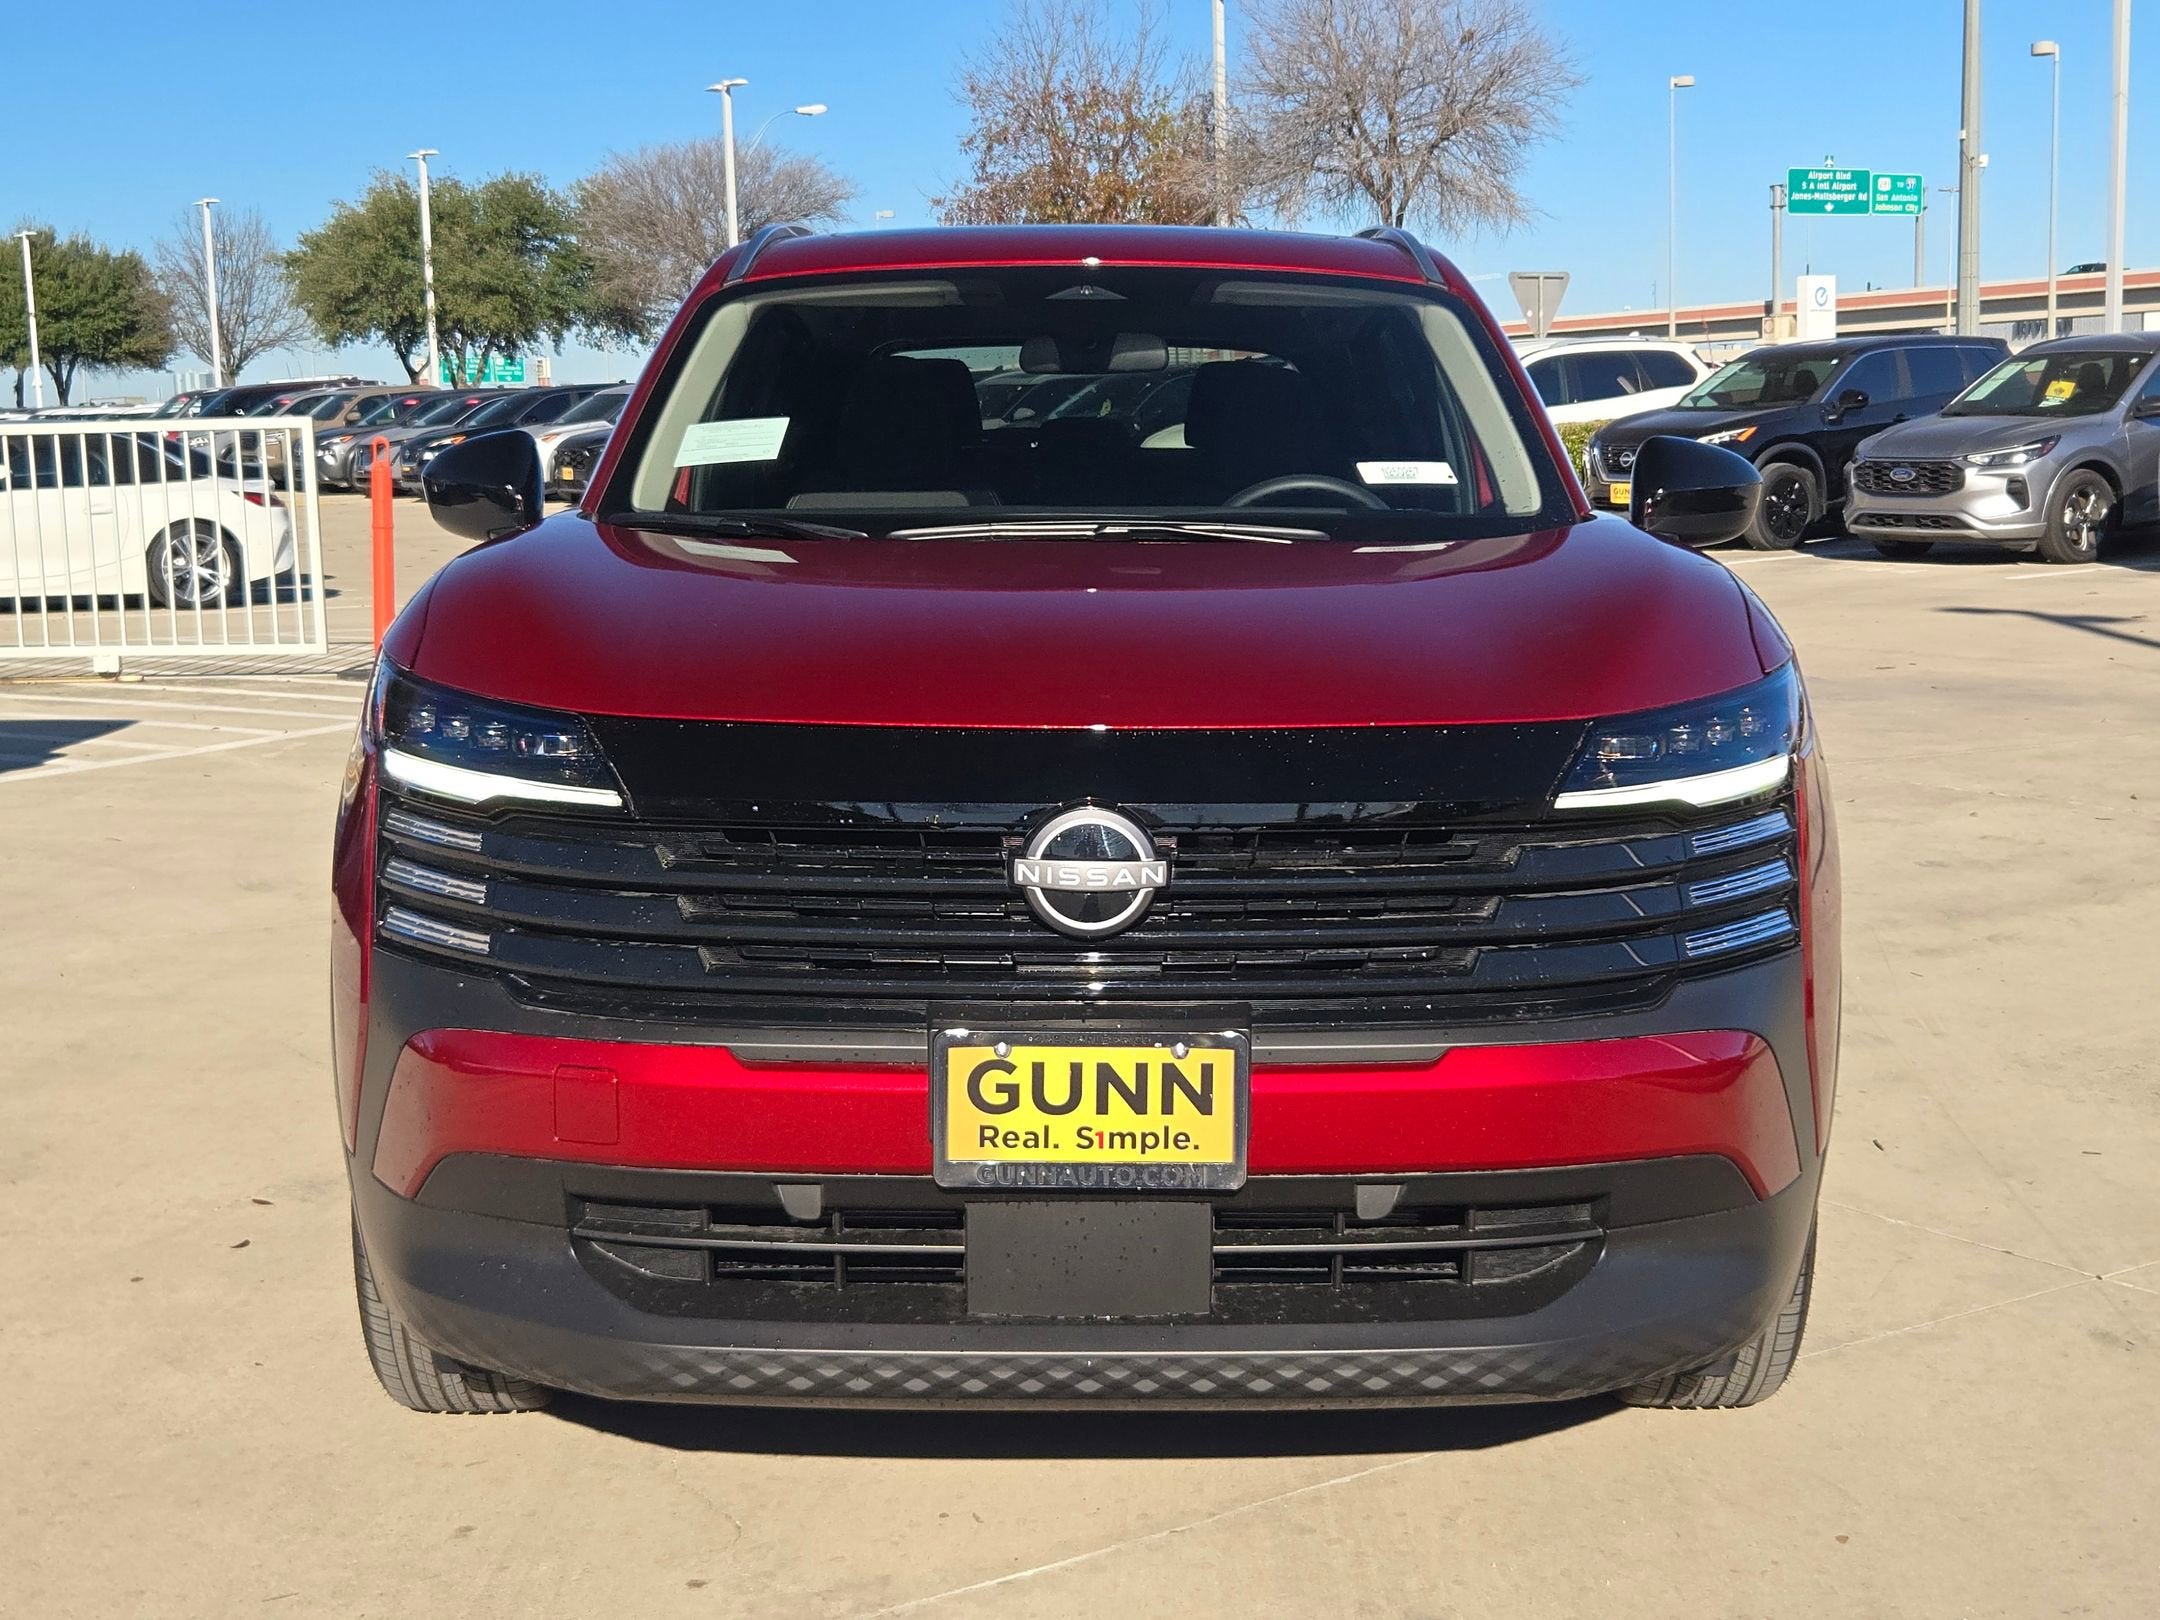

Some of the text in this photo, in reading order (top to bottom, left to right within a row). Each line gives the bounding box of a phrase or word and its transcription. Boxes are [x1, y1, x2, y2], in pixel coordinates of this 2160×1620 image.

[1808, 171, 1851, 181] Airport Blvd
[1832, 182, 1857, 191] Airport
[1891, 193, 1918, 202] Antonio
[1875, 203, 1919, 213] Johnson City
[1017, 864, 1165, 886] NISSAN
[966, 1058, 1214, 1116] GUNN
[979, 1124, 1060, 1149] Real.
[975, 1164, 1207, 1187] GUNNAUTO.COM
